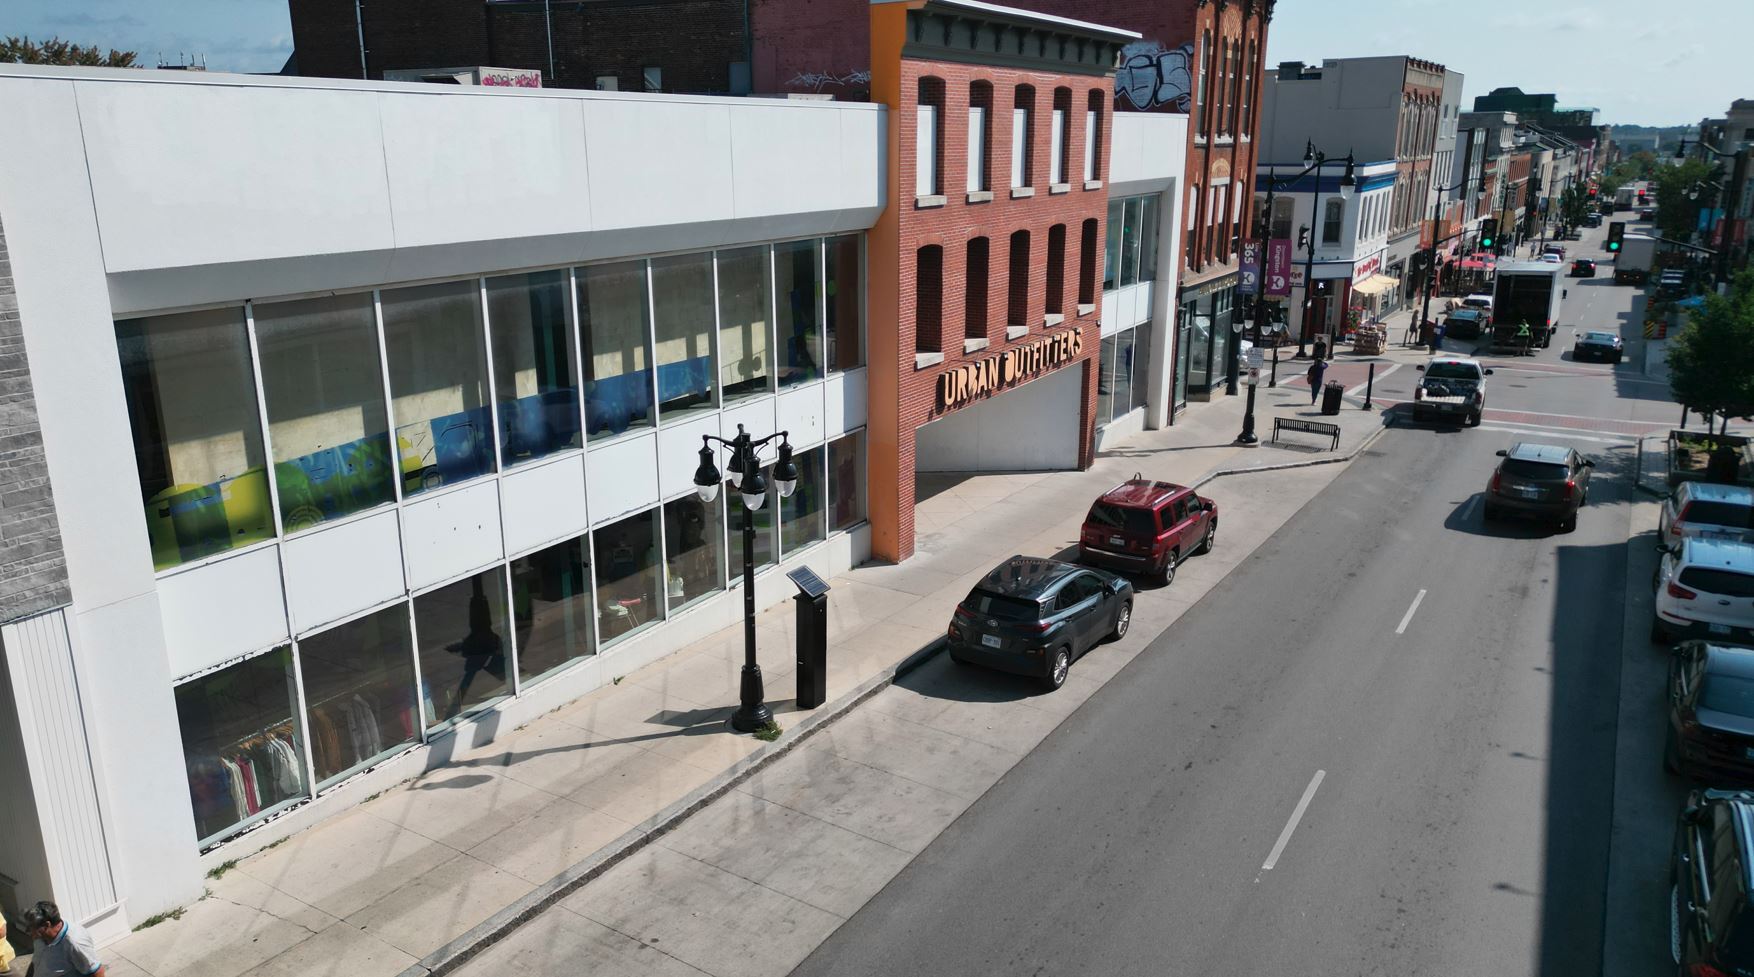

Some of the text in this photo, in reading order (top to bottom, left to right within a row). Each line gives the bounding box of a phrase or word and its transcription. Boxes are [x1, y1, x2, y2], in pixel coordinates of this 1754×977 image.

[1244, 242, 1255, 264] 365
[943, 328, 1083, 406] URBAN OUTFITTERS
